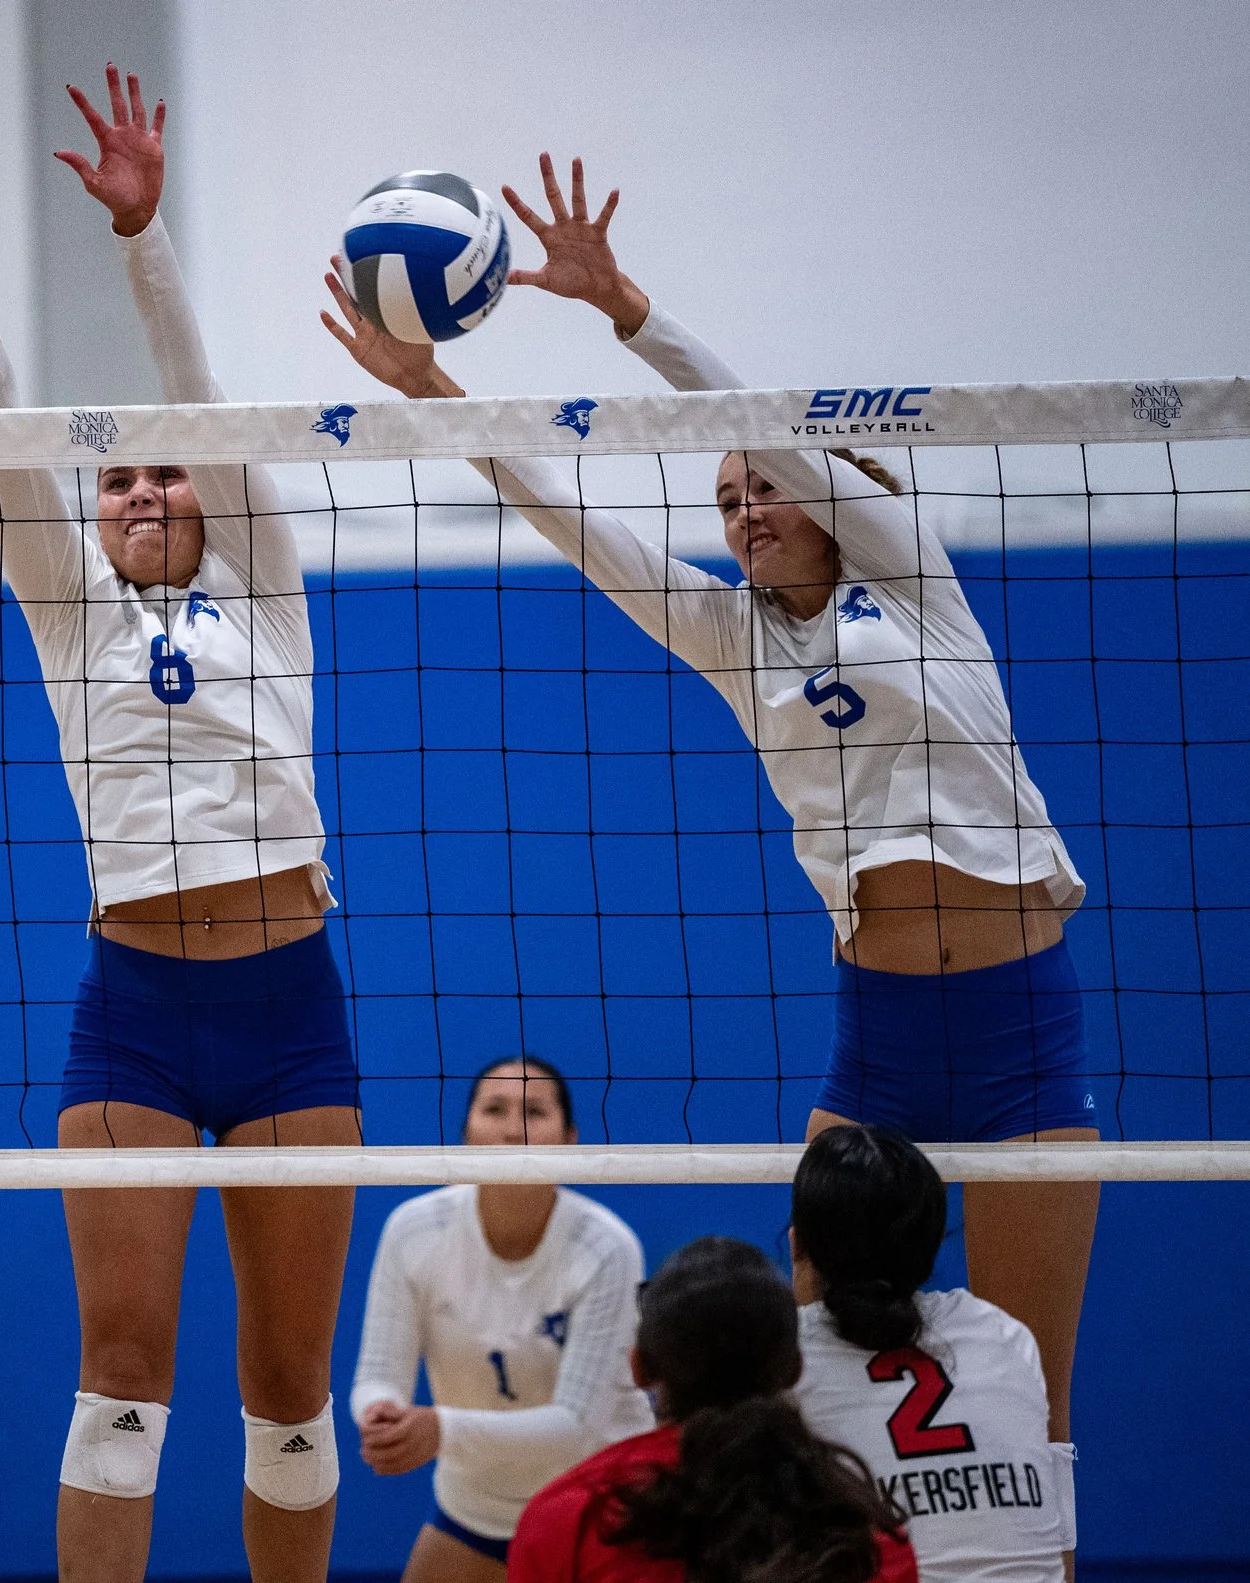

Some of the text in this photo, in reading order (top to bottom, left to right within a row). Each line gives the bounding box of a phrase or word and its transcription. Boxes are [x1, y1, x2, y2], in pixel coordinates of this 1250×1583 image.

[1134, 383, 1179, 398] SANTA
[804, 387, 933, 420] SMC
[1131, 396, 1184, 409] MONICA
[71, 410, 115, 423] SANTA
[1133, 407, 1182, 428] COLLEGE
[68, 422, 119, 435] MONICA
[790, 422, 936, 435] VOLLEYBALL
[69, 433, 118, 453] COLLEGE
[150, 633, 196, 705] 8
[803, 663, 867, 730] 5
[488, 1350, 519, 1401] 1
[866, 1343, 976, 1461] 2
[112, 1419, 146, 1433] adidas
[280, 1443, 314, 1454] adidas
[877, 1462, 1044, 1517] KERSFIELD
